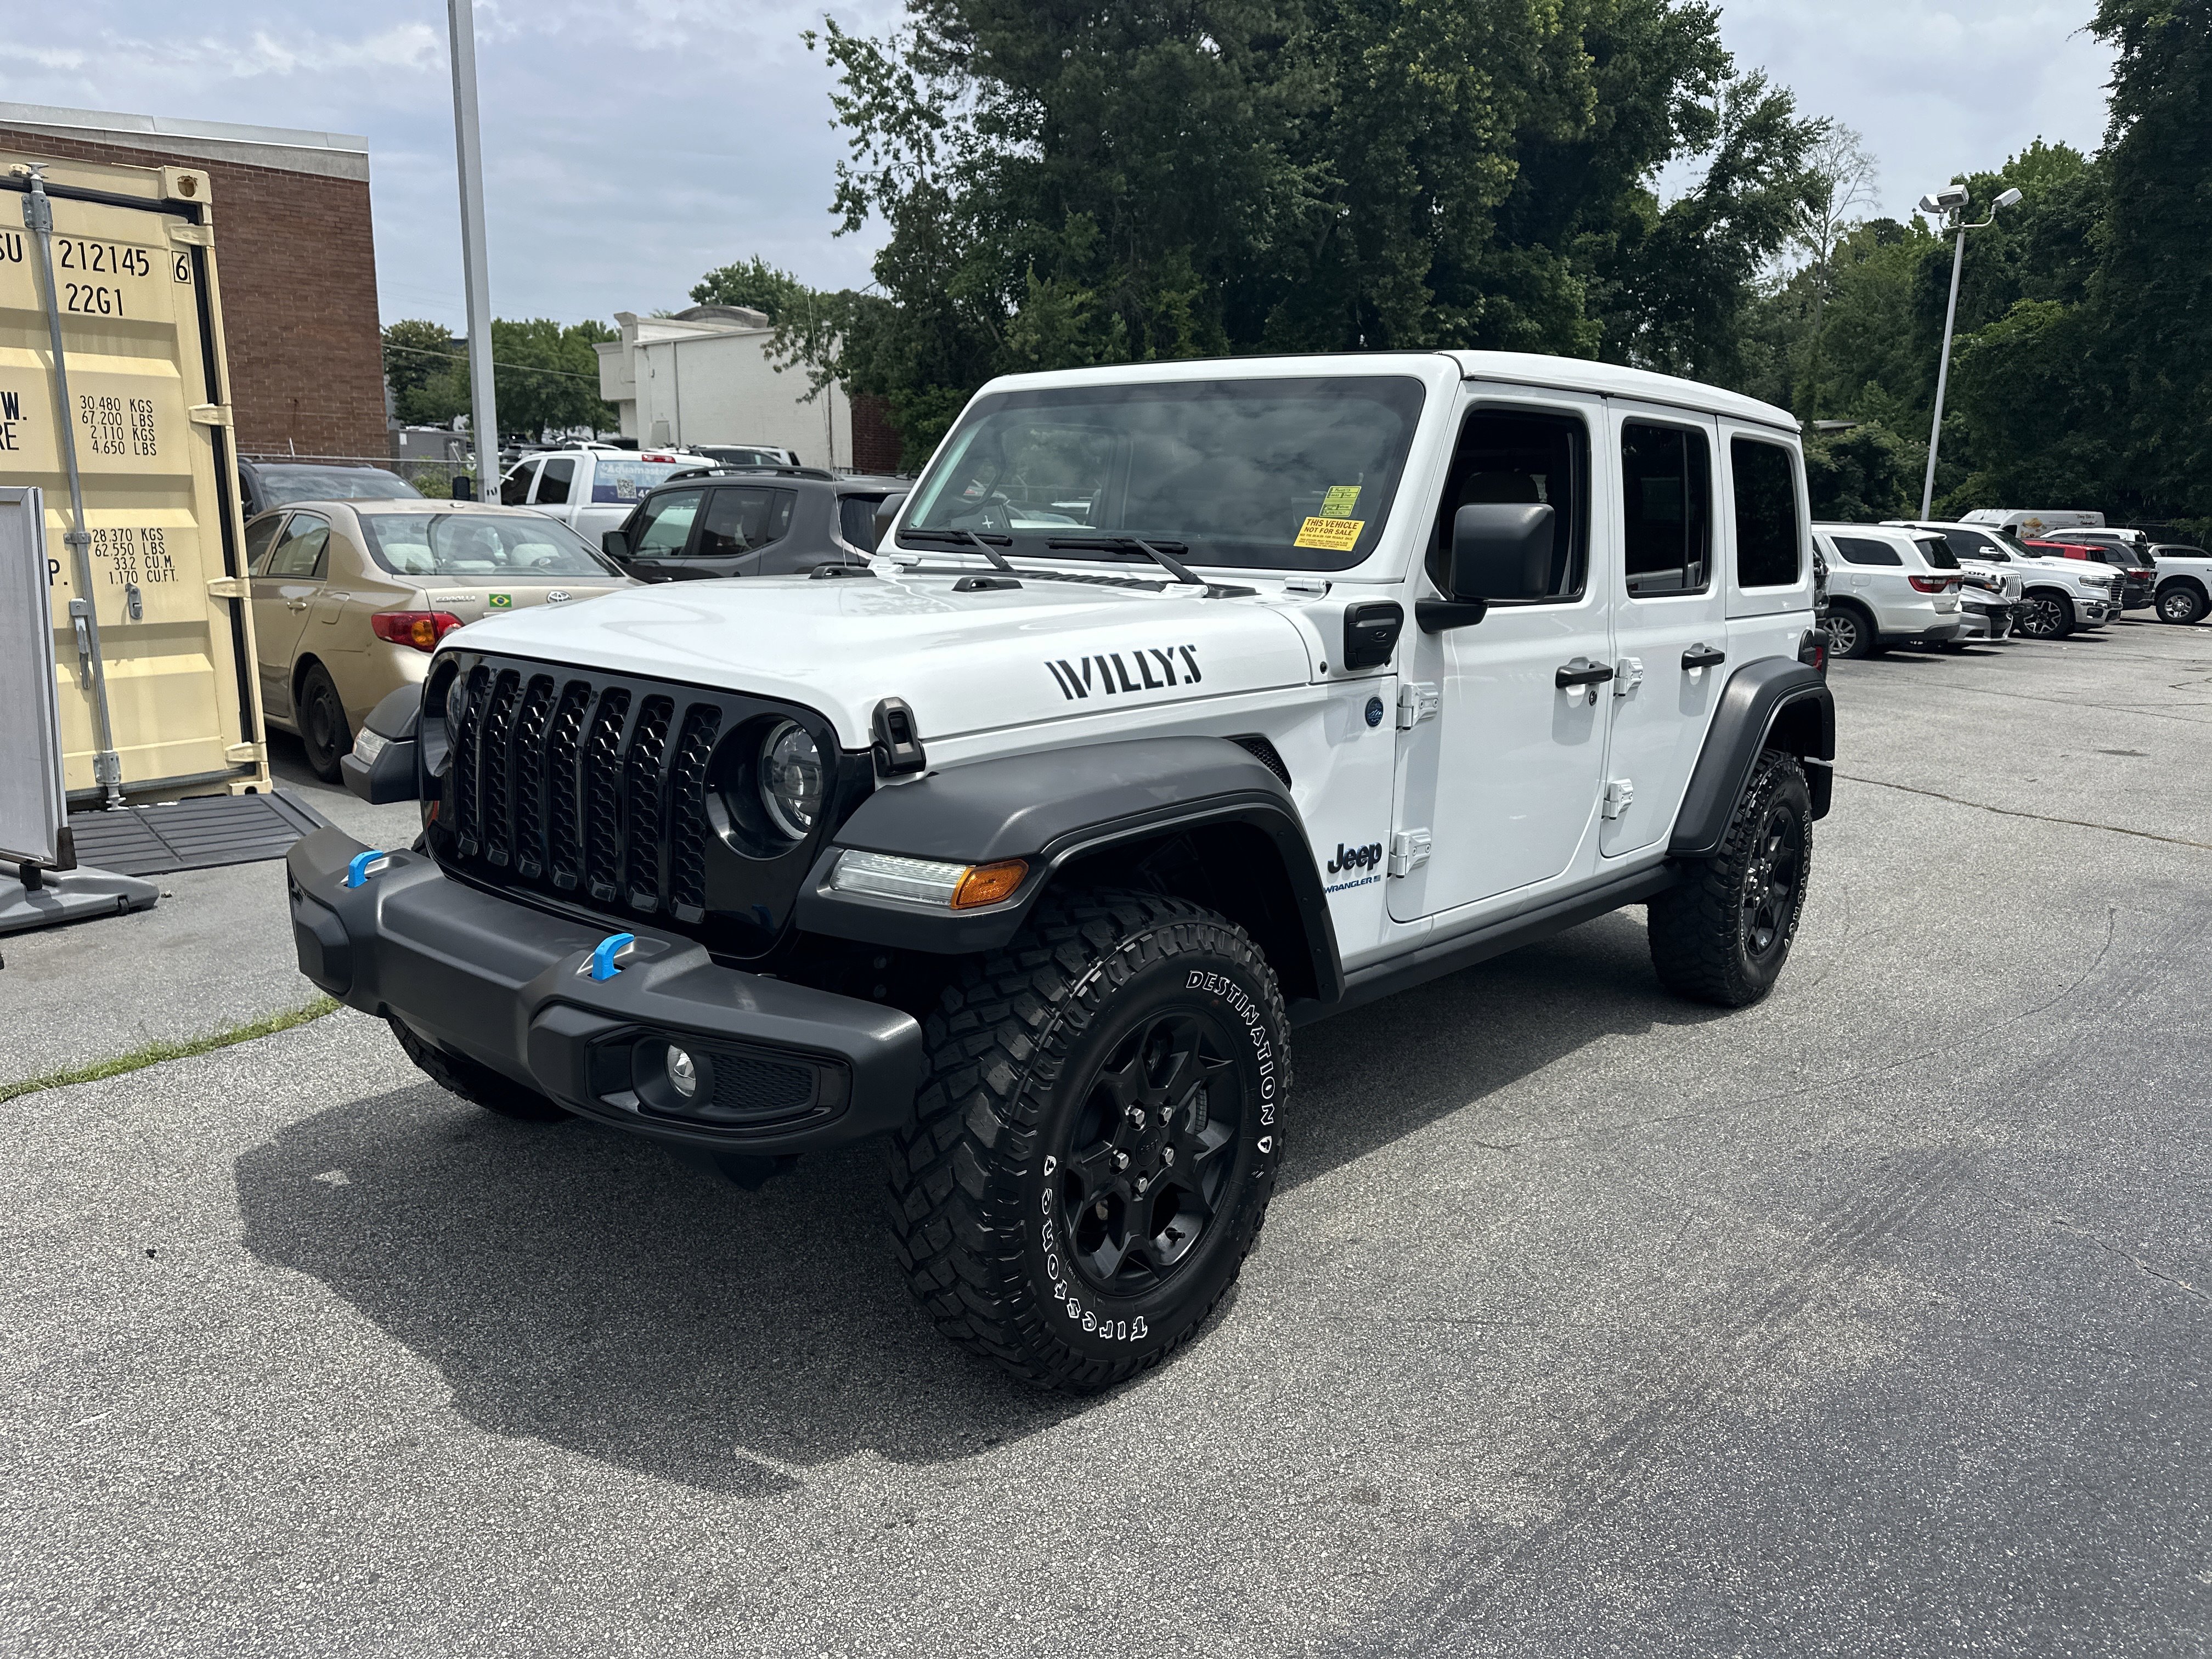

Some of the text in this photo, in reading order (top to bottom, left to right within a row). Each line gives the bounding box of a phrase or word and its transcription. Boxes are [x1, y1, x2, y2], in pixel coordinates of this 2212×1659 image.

[59, 240, 149, 276] 212145
[66, 283, 123, 316] 22G1
[130, 399, 153, 413] KGS
[131, 413, 154, 427] LBS
[133, 427, 155, 442] KGS
[134, 442, 156, 456] LBS
[607, 465, 670, 475] Aquamaster
[1325, 520, 1359, 529] VEHICLE
[141, 528, 163, 541] KGS
[143, 541, 165, 555] LBS
[114, 557, 136, 570] 33.2
[1043, 644, 1201, 700] WILLYS
[1328, 842, 1383, 873] Jeep
[1324, 877, 1372, 894] WRANGLER
[1185, 969, 1276, 1127] DESTINATION
